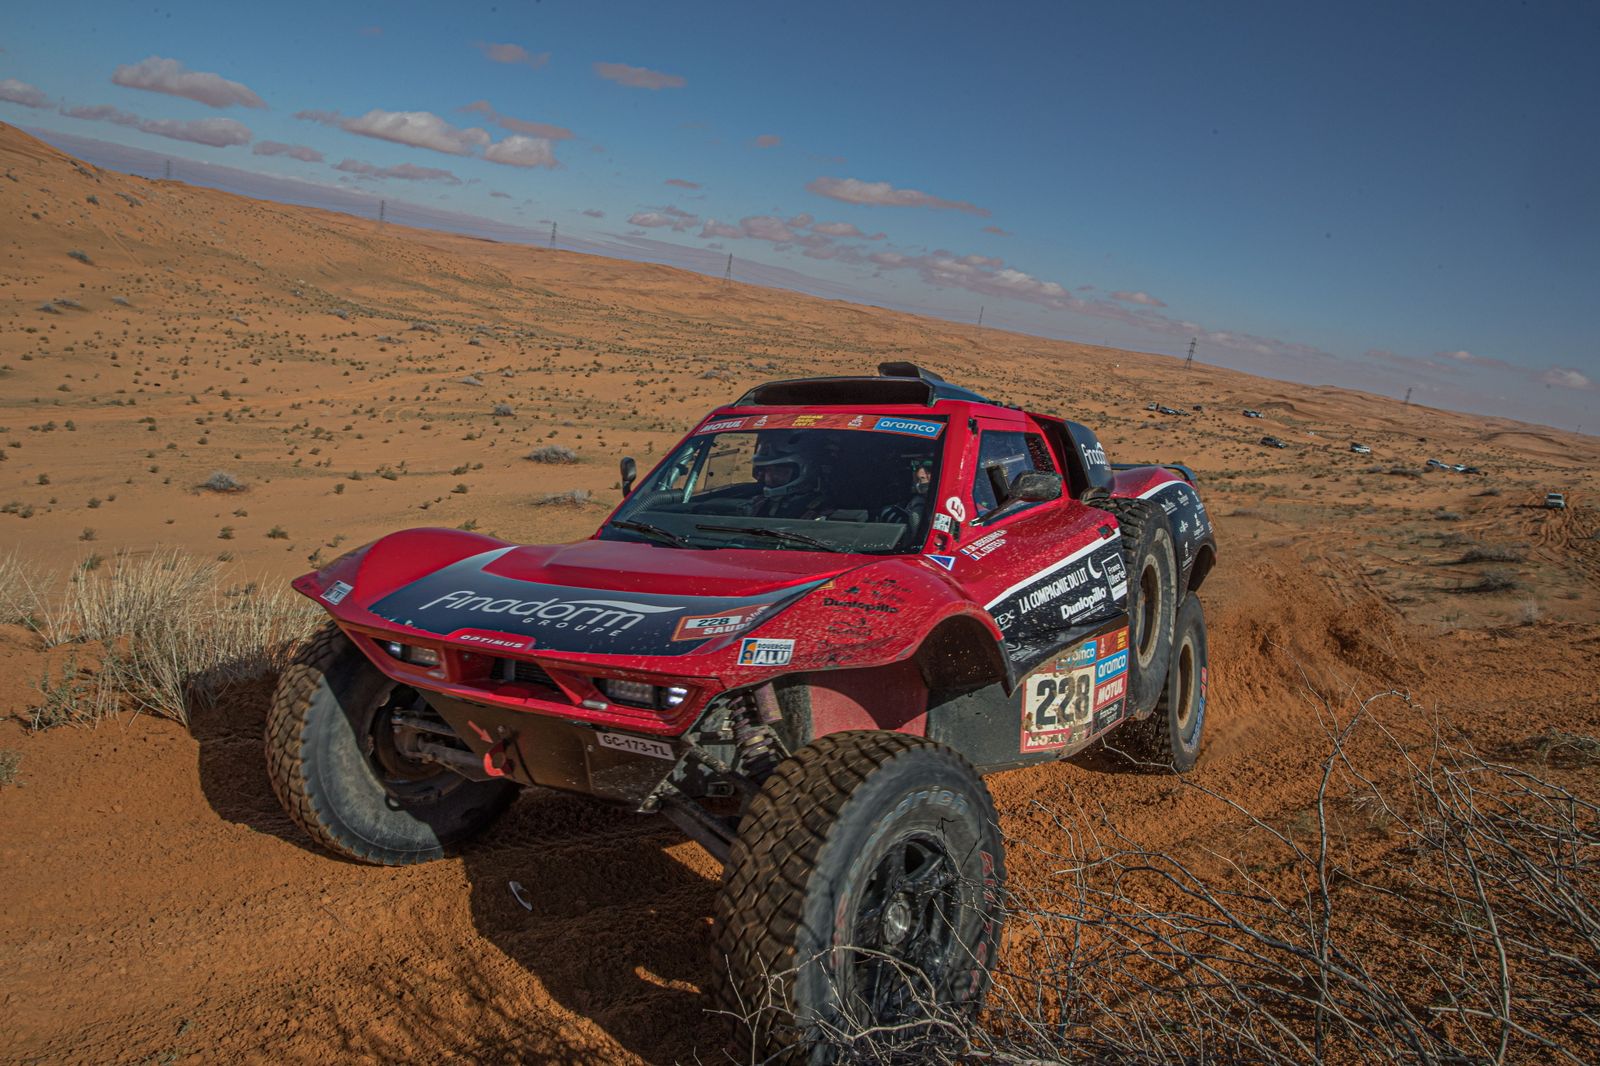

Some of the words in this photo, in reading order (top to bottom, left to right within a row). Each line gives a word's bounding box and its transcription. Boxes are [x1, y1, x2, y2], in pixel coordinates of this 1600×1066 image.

[700, 421, 742, 432] MOTUL
[880, 420, 935, 433] aramco
[1018, 598, 1031, 614] LA
[1029, 577, 1071, 608] COMPAGNIE
[1067, 572, 1080, 590] DU
[1076, 567, 1089, 583] LIT
[1060, 586, 1107, 620] Dunlopillo
[522, 617, 623, 637] GROUPE
[697, 617, 730, 628] 228
[460, 634, 524, 648] OPTIMUS
[755, 650, 790, 664] ALU
[1098, 654, 1127, 678] aramco
[1036, 674, 1090, 726] 228
[1096, 678, 1124, 706] MOTUL
[603, 734, 669, 757] GC-173-TL
